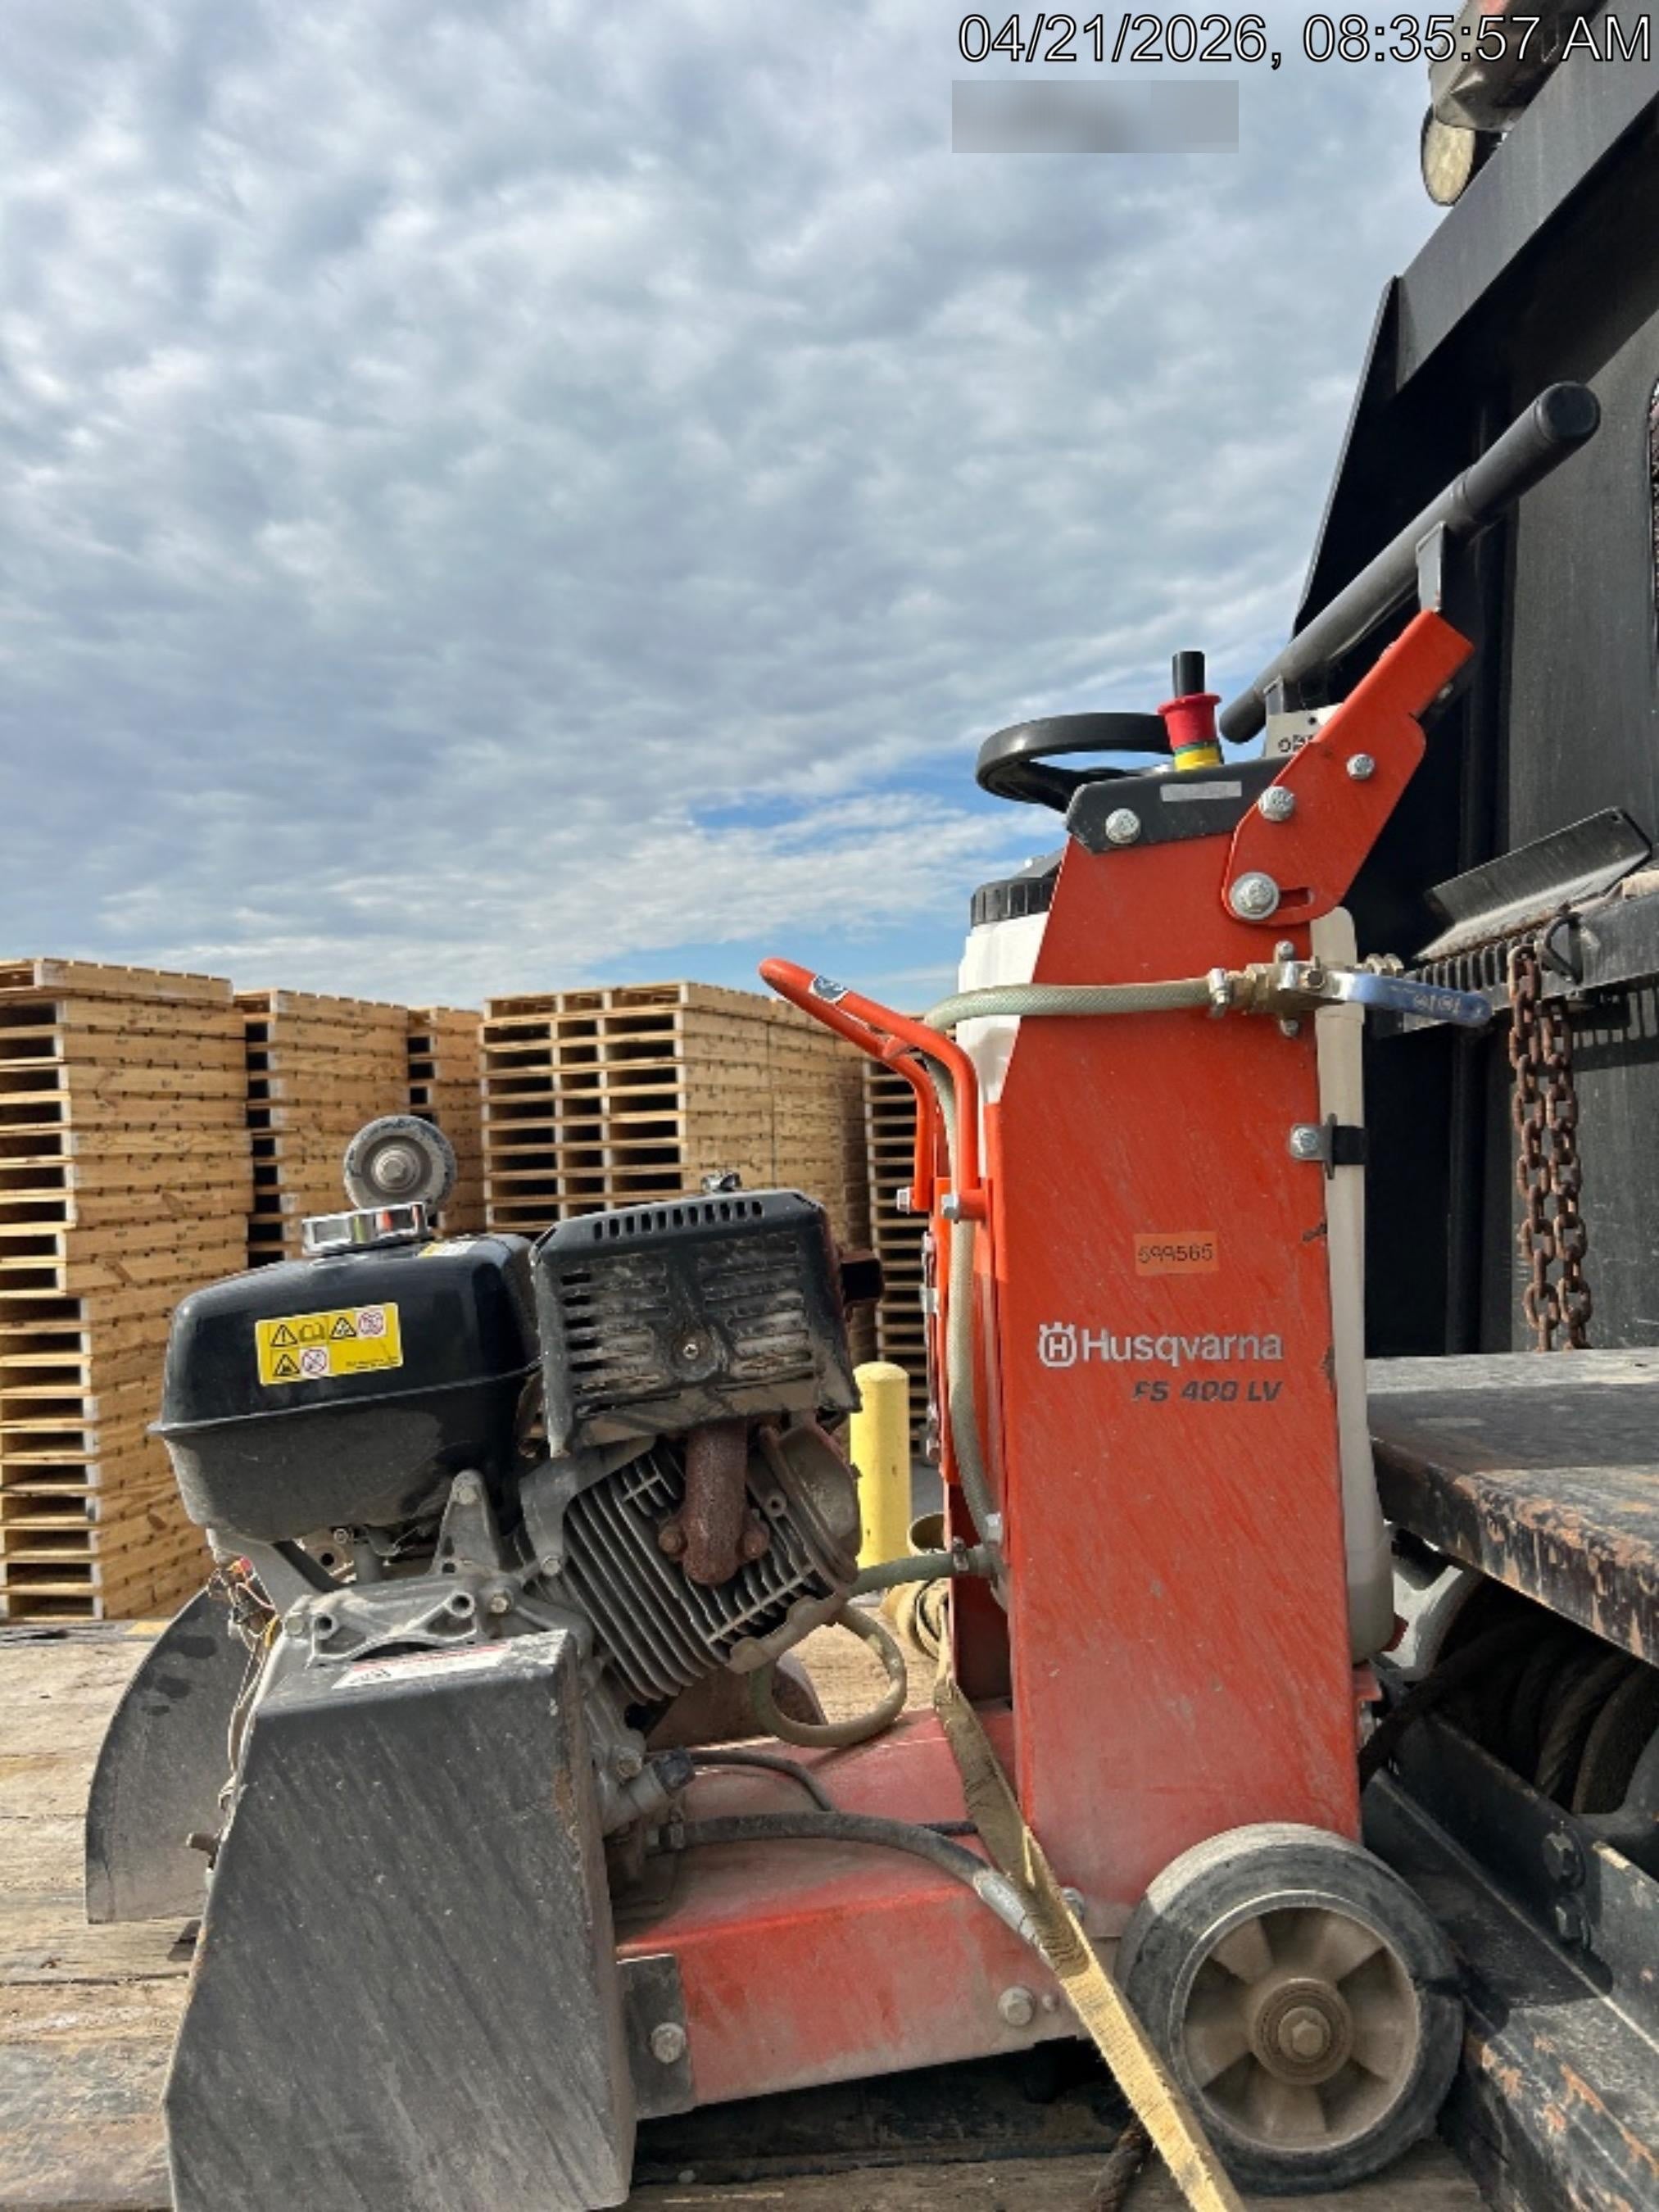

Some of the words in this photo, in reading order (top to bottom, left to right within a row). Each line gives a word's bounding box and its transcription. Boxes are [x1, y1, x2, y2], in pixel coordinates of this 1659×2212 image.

[1081, 1328, 1284, 1367] Husqvarna
[1133, 1380, 1169, 1403] FS
[1181, 1380, 1240, 1402] 400
[1247, 1380, 1284, 1402] LV
